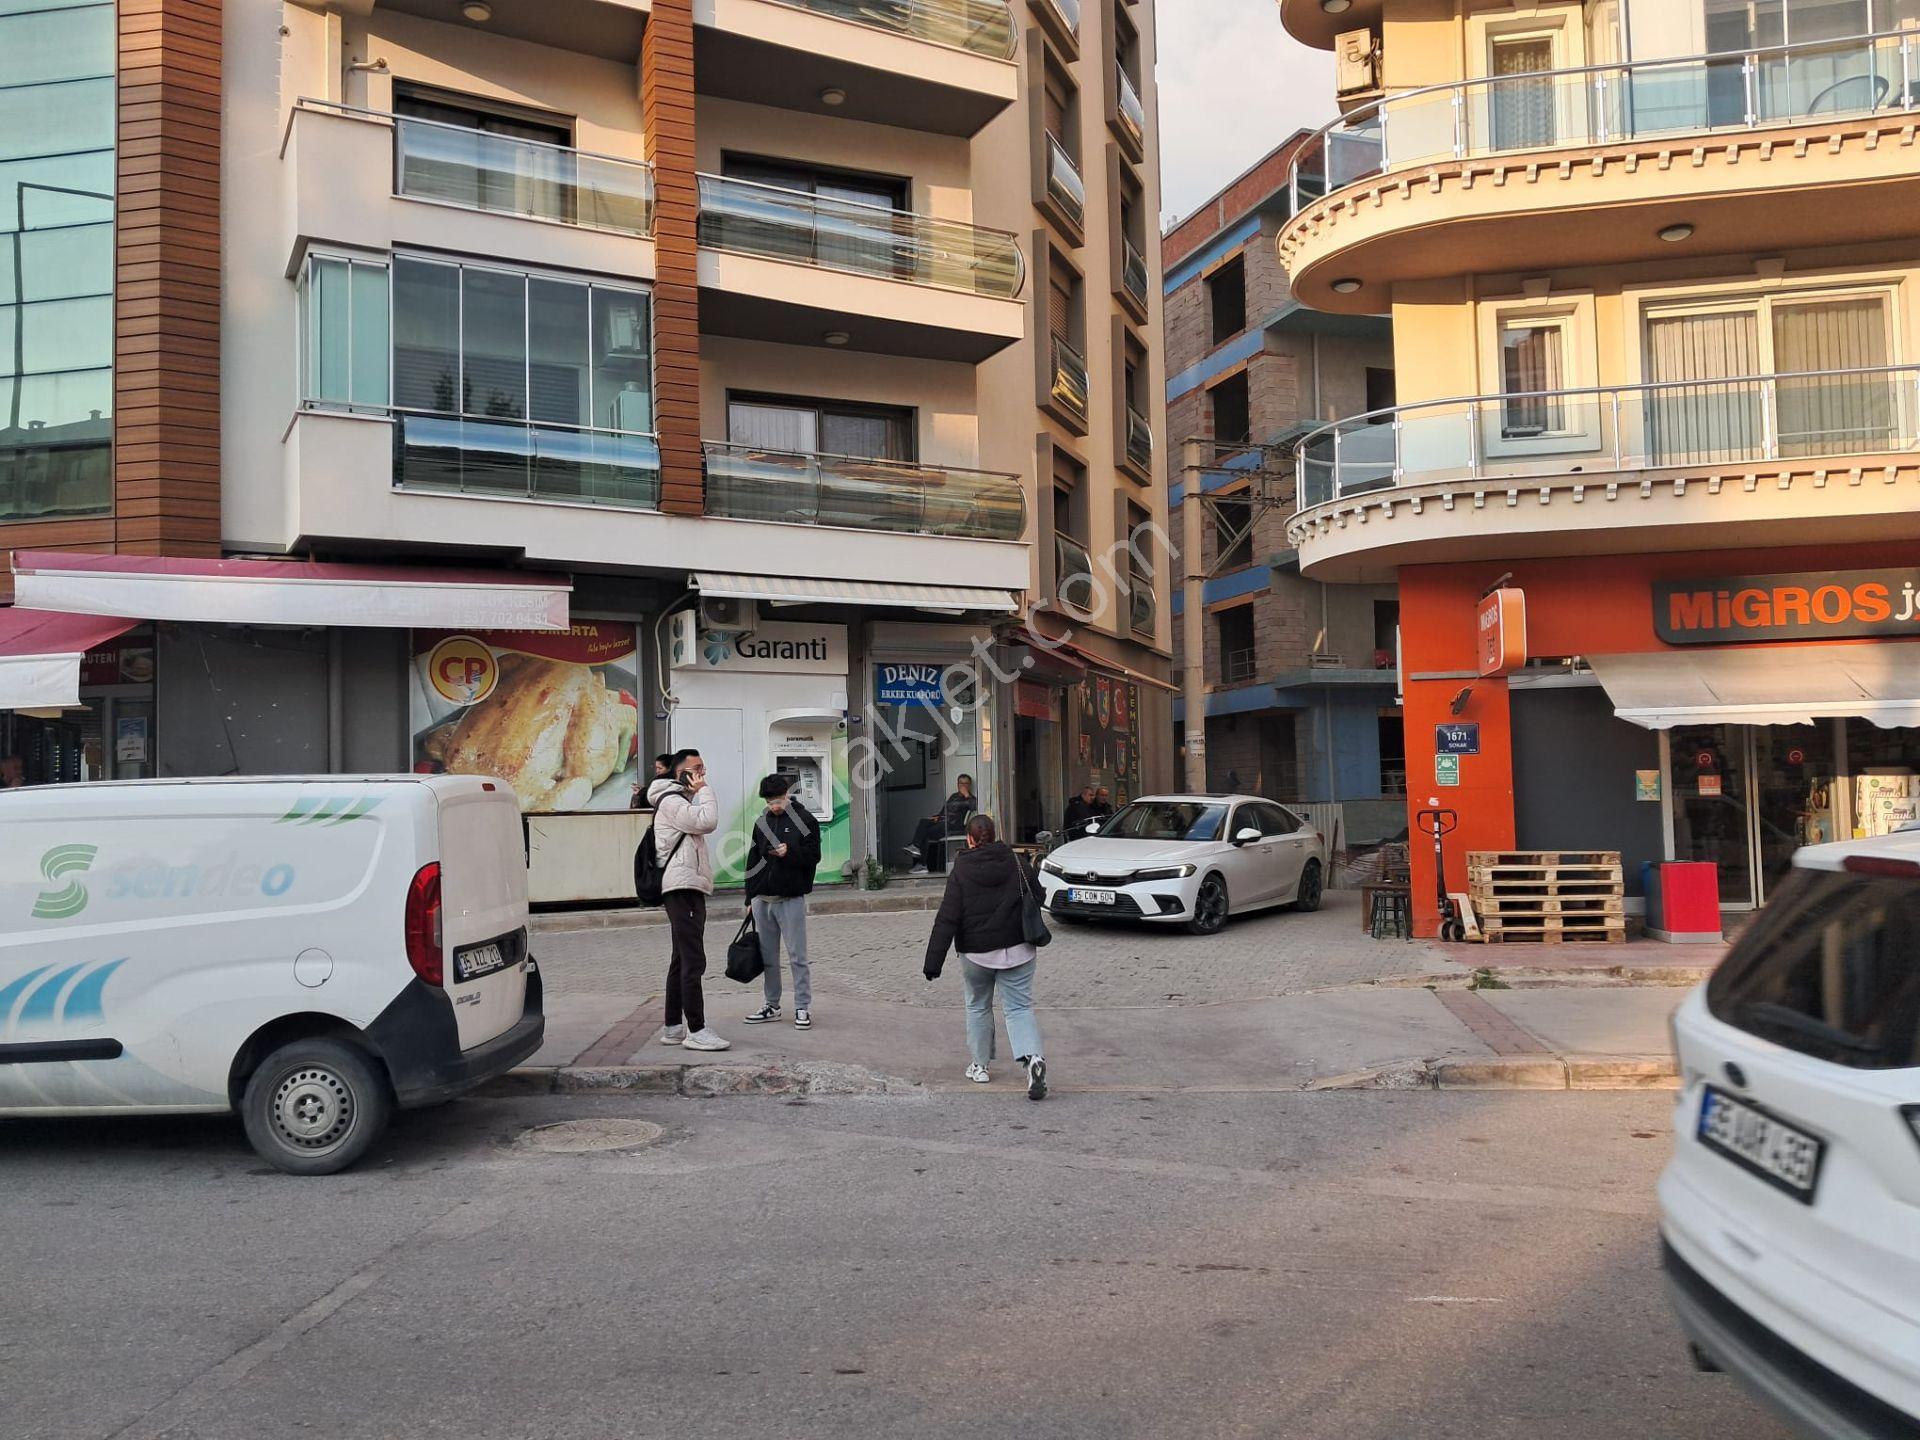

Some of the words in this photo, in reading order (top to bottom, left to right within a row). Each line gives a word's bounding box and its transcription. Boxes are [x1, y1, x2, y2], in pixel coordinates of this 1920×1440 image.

[735, 633, 827, 661] Garanti
[881, 689, 905, 699] ERKEK
[1073, 890, 1082, 900] 35
